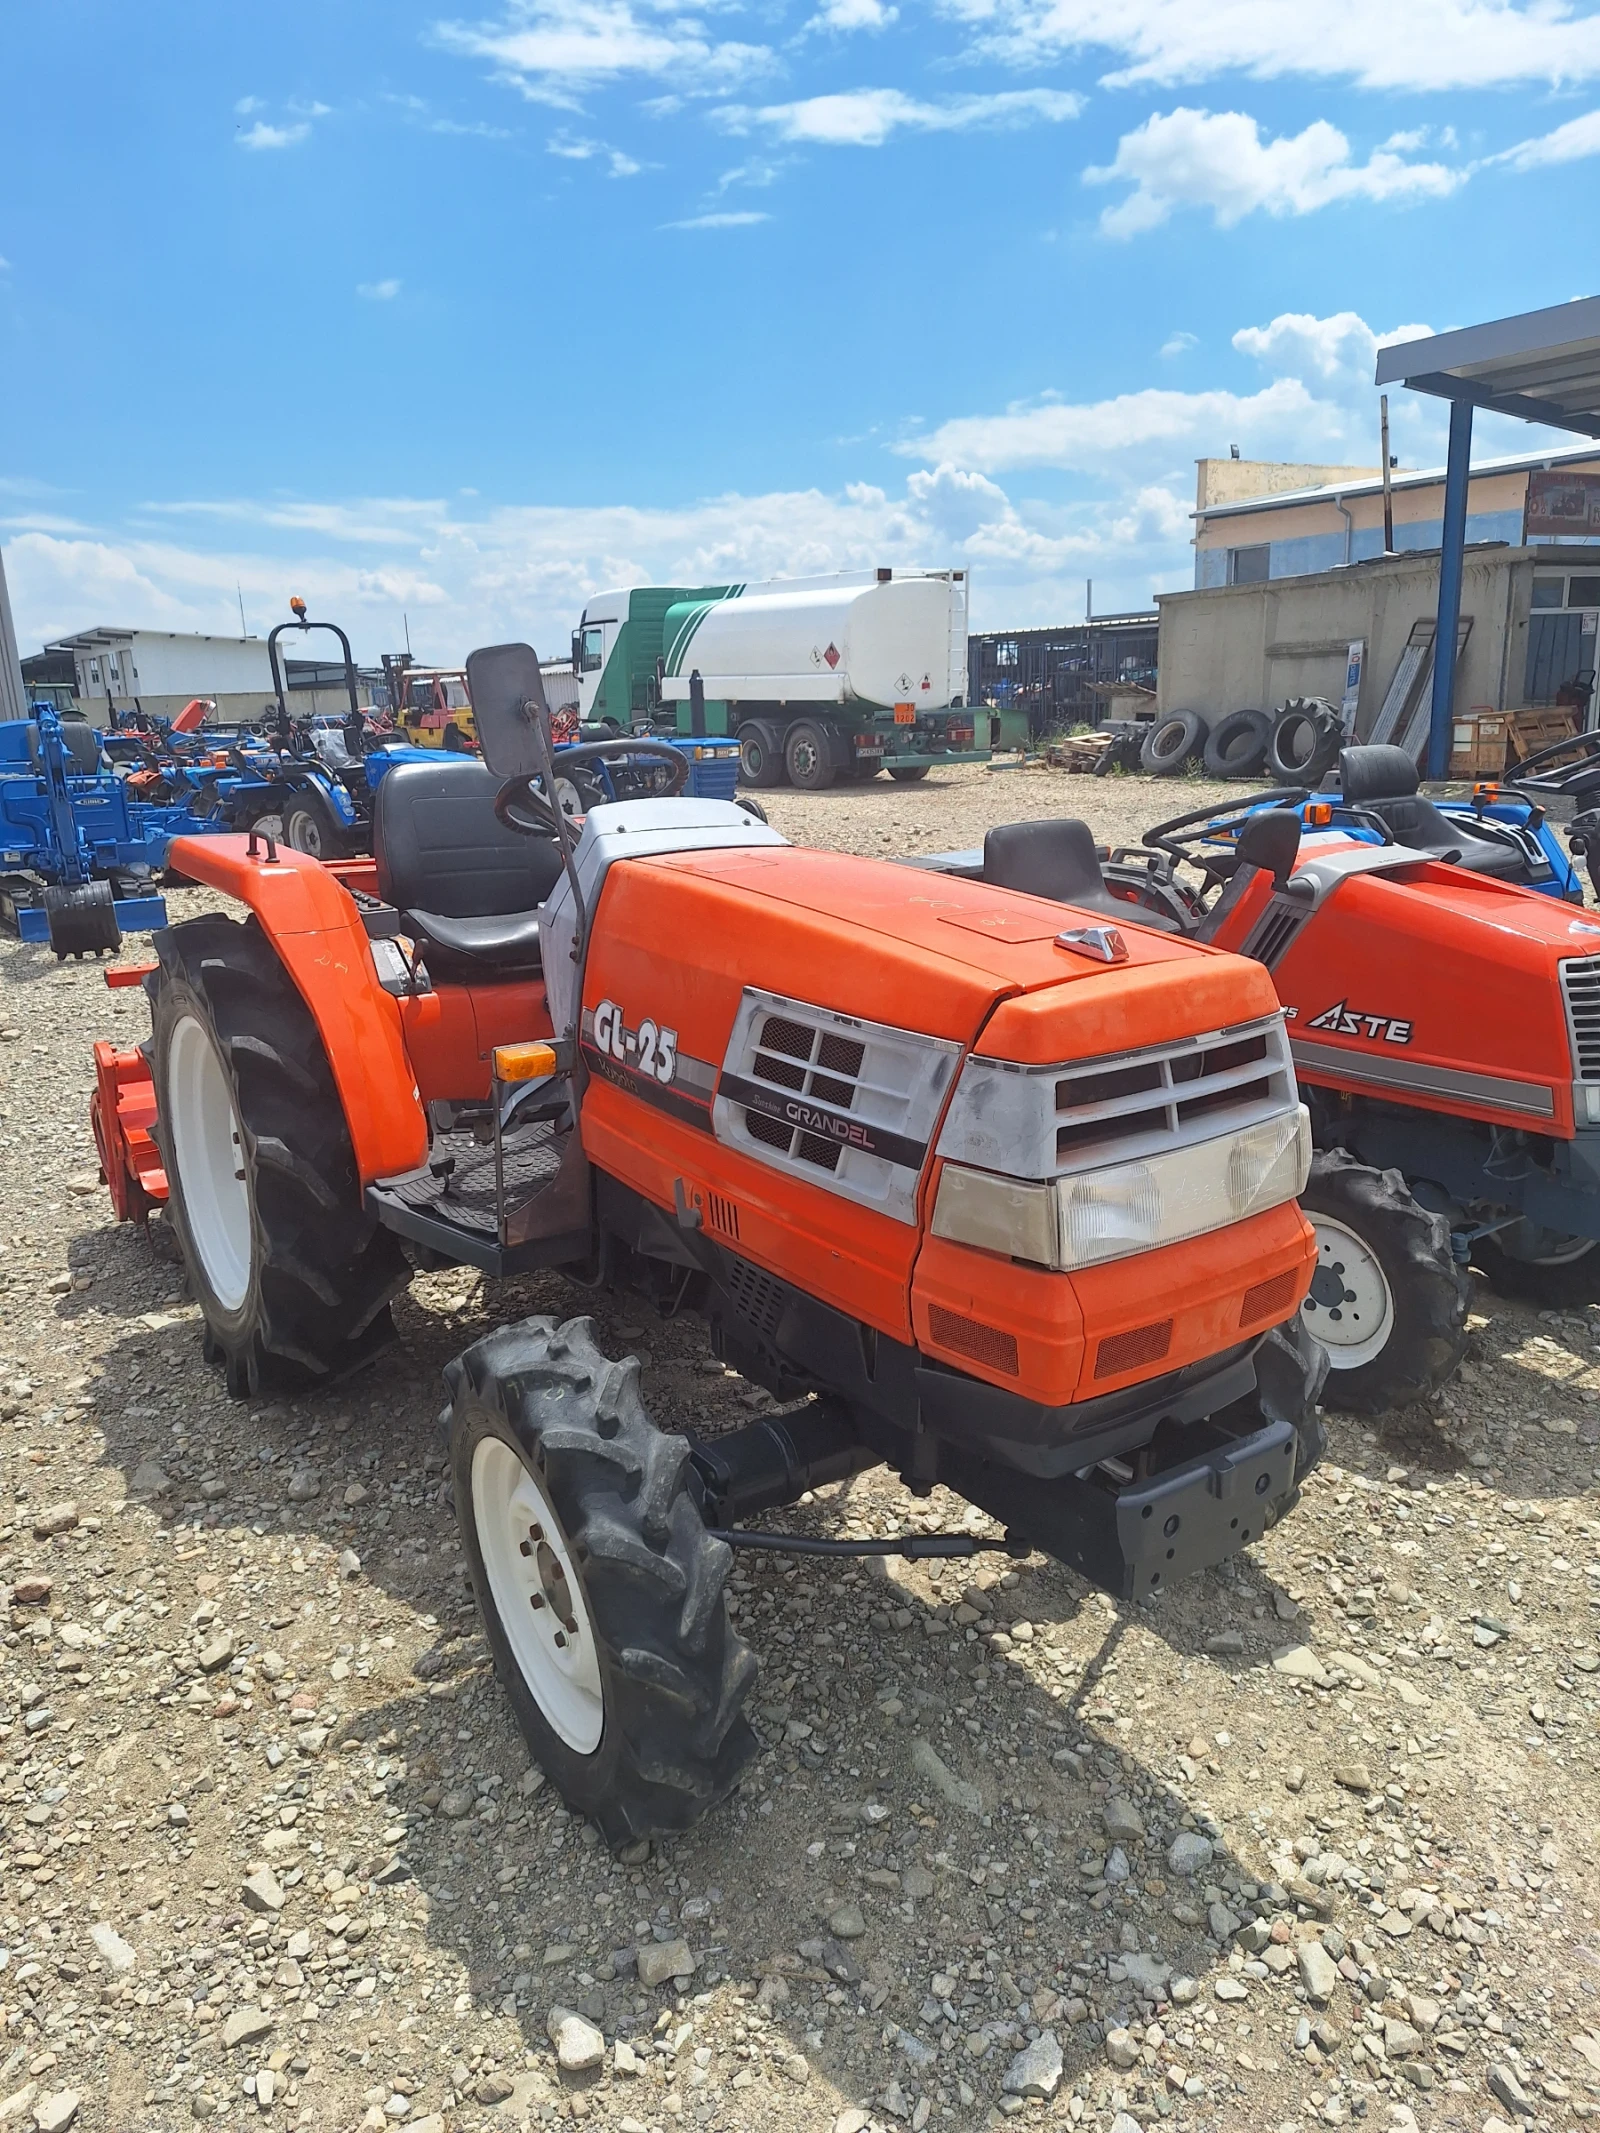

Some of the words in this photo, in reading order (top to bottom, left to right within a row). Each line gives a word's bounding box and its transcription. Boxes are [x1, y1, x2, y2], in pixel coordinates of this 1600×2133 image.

[1349, 664, 1357, 684] parts
[896, 714, 915, 722] 1202
[905, 703, 915, 711] 30
[1306, 1000, 1412, 1044] ASTE
[594, 1000, 677, 1085] GL-25
[751, 1093, 781, 1114] Sunshine
[785, 1101, 876, 1149] GRANDEL
